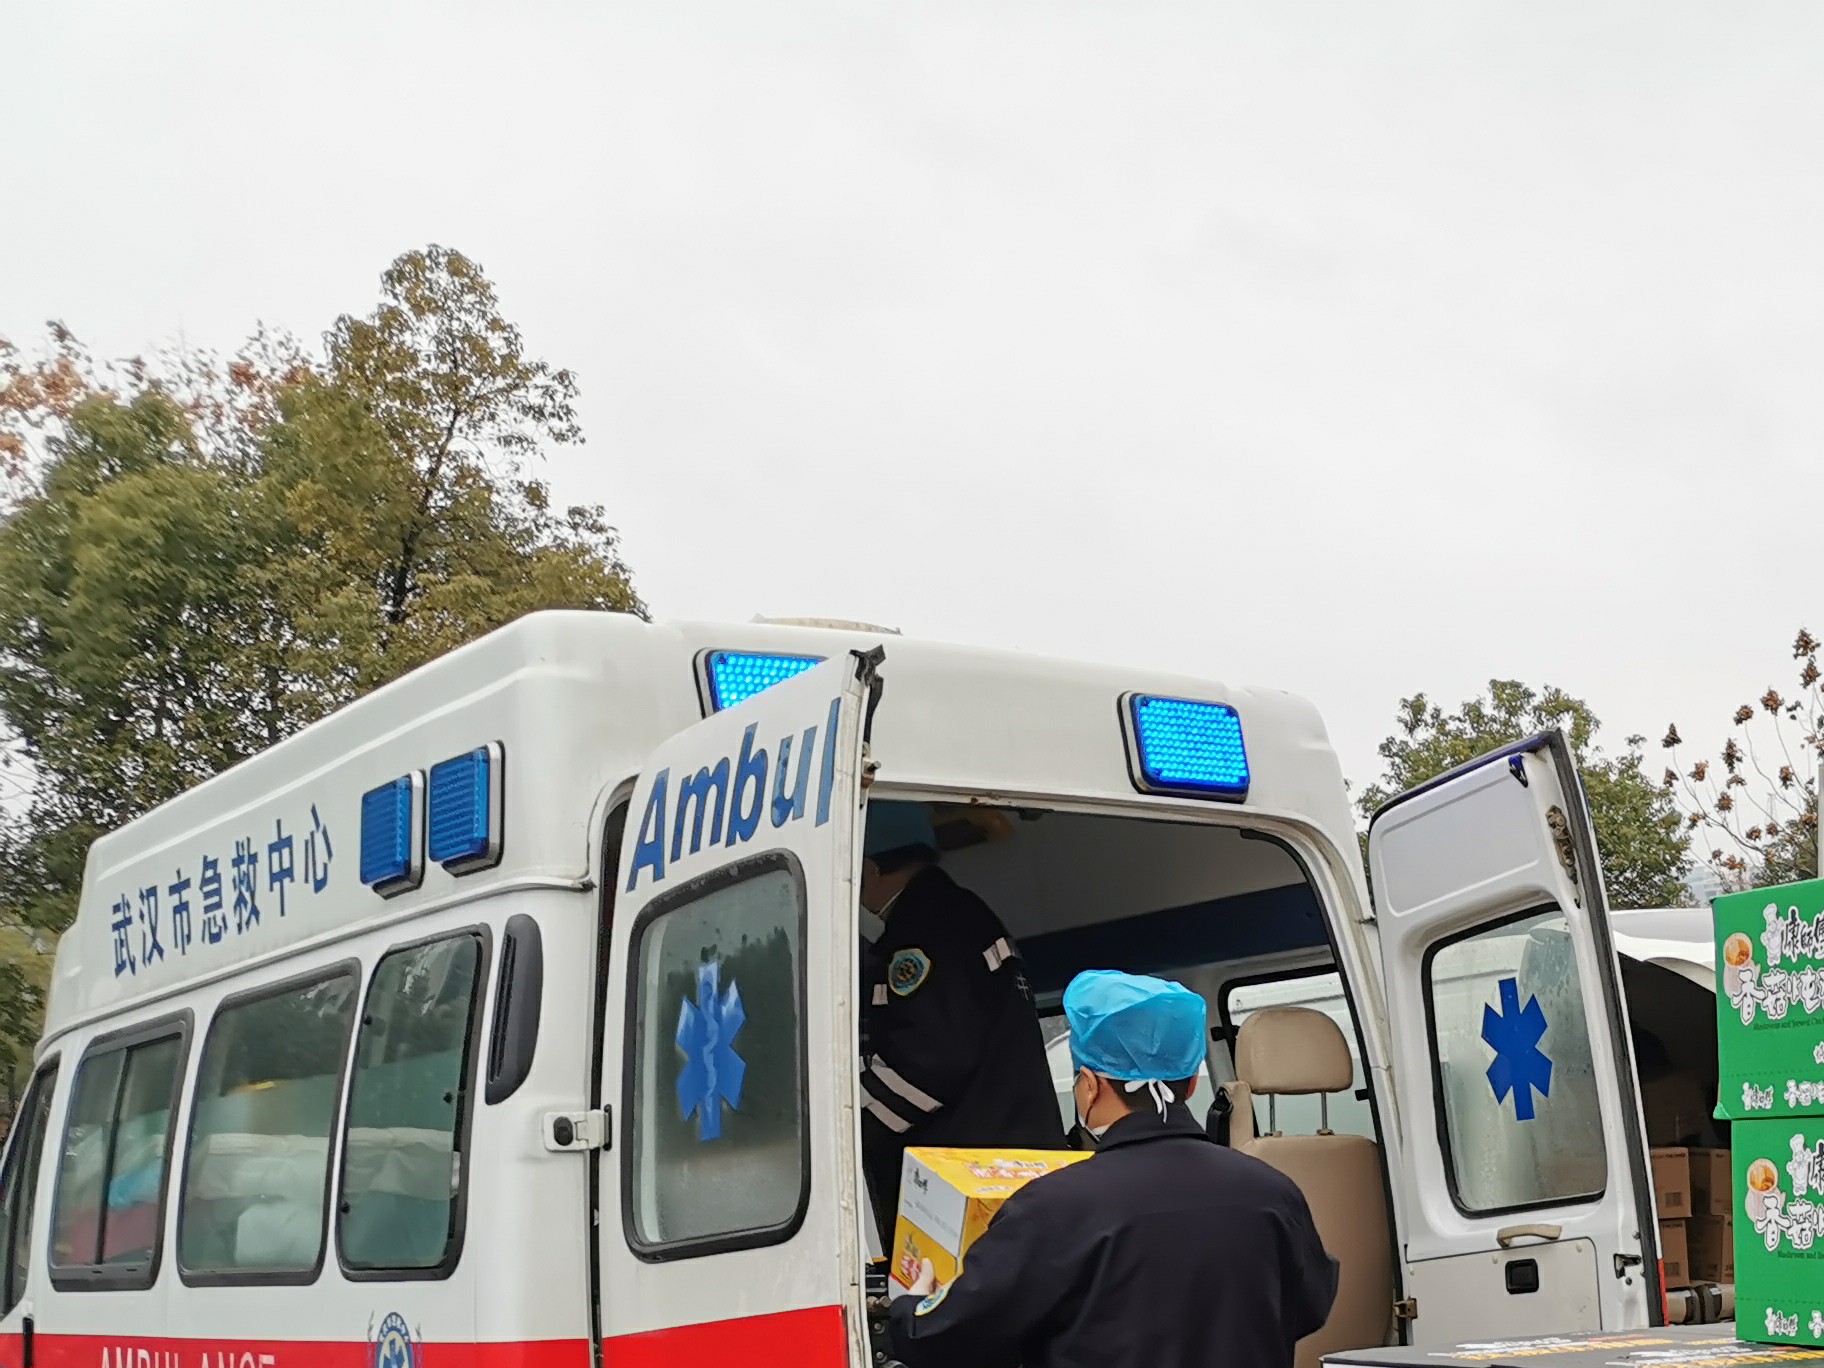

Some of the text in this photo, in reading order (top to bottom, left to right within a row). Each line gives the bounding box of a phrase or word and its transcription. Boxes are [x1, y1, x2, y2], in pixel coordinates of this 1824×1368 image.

[624, 698, 842, 895] Ambul
[111, 805, 334, 978] 武汉市急救中心
